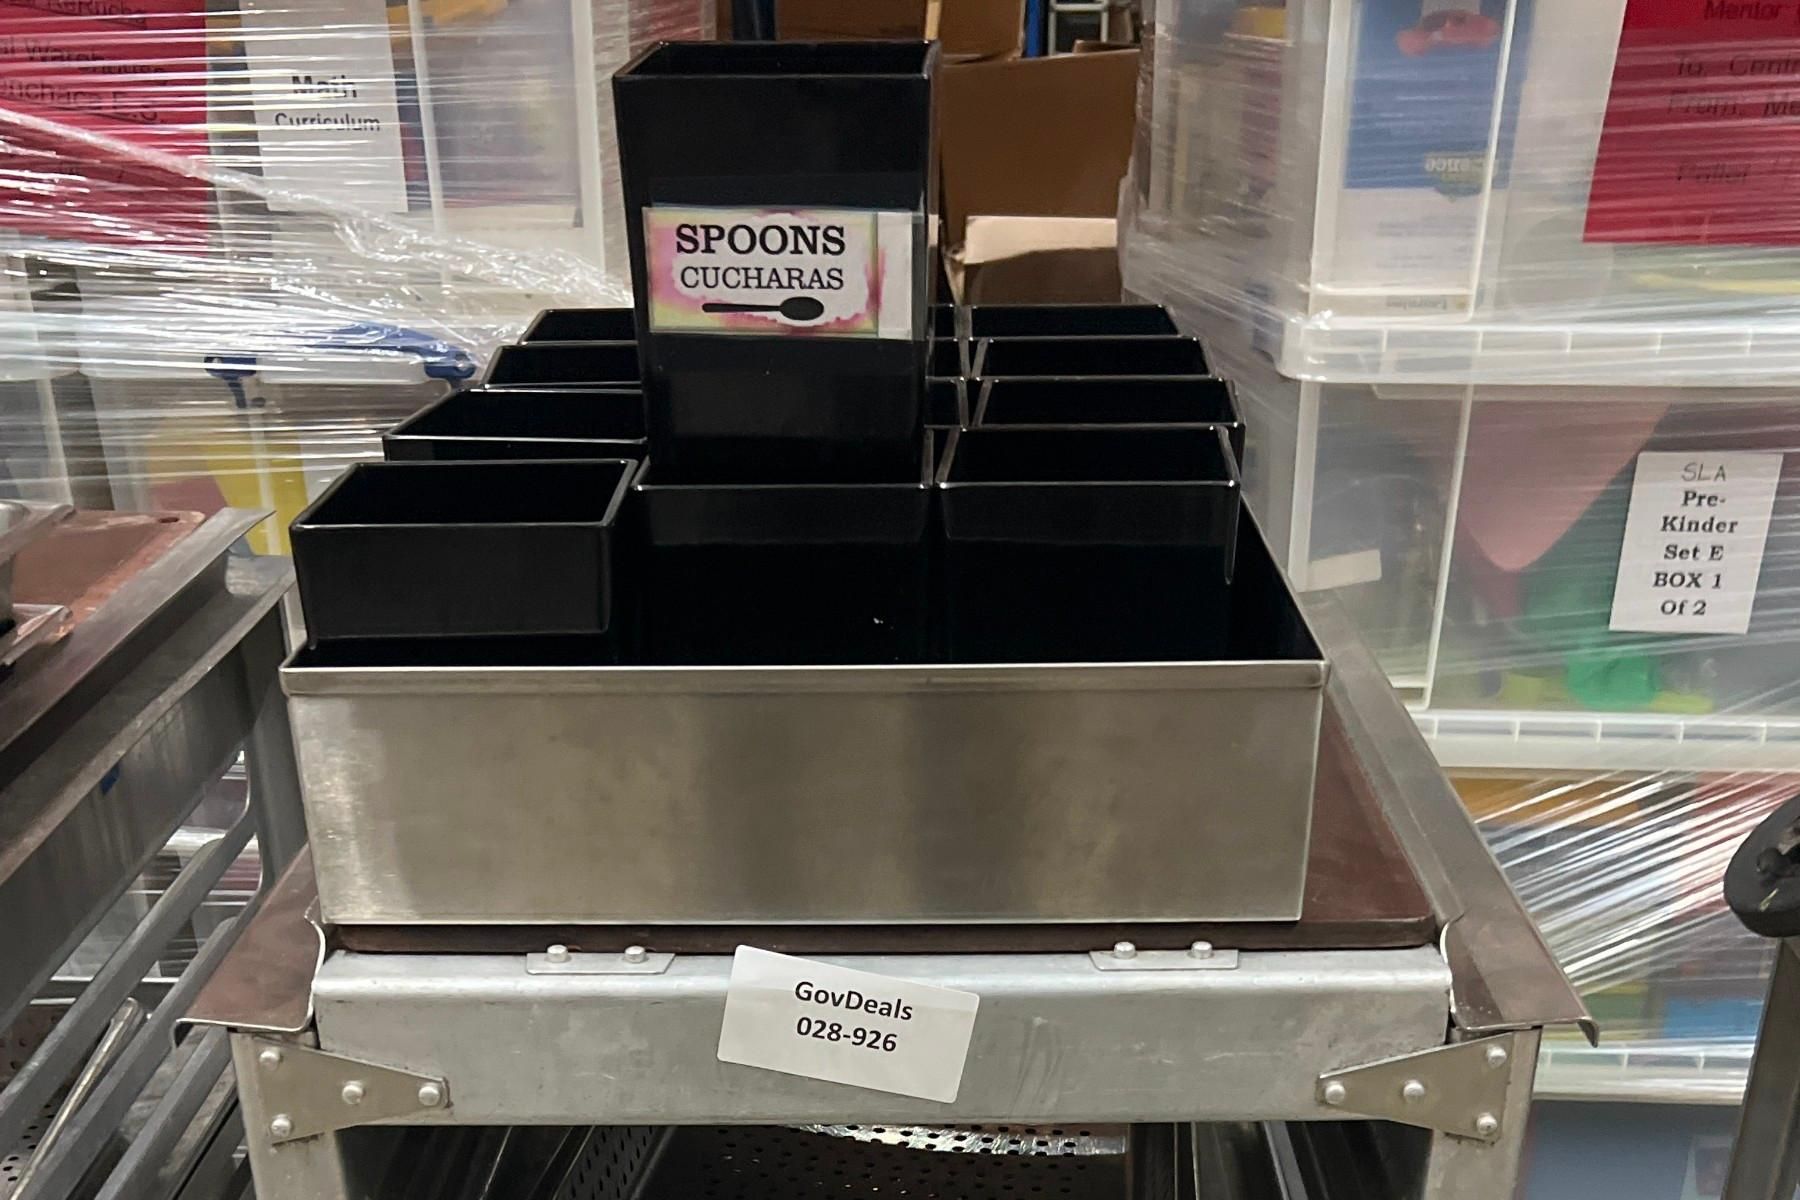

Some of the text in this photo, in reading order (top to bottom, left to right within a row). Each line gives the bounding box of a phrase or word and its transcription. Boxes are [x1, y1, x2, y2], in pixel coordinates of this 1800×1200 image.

[292, 75, 358, 98] Math
[274, 111, 381, 131] Curriculum
[675, 223, 846, 255] SPOONS
[680, 266, 845, 290] CUCHARAS
[1681, 462, 1727, 482] SLA
[1681, 490, 1726, 507] Pre-
[1660, 515, 1739, 534] Kinder
[1663, 544, 1725, 561] Set E
[1652, 572, 1722, 589] BOX 1
[1660, 600, 1707, 615] Of 2
[794, 981, 913, 1020] GovDeals
[796, 1016, 898, 1052] 028-926
